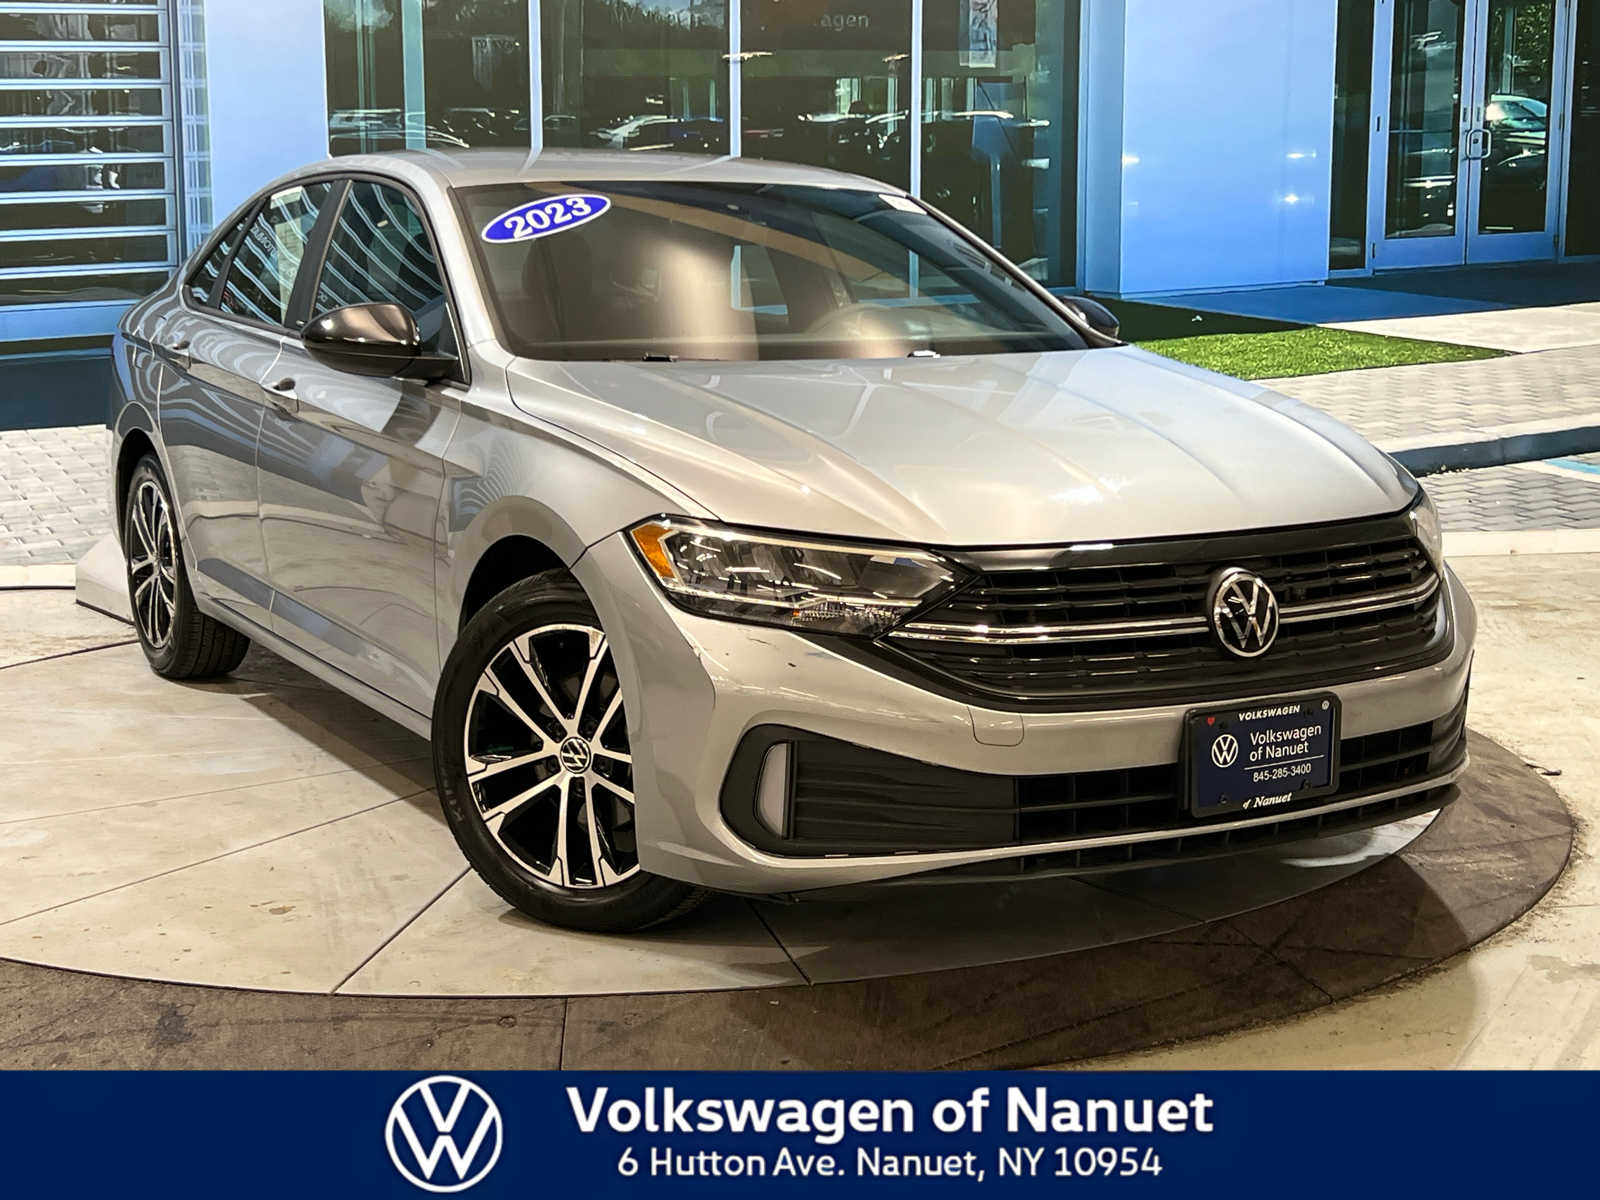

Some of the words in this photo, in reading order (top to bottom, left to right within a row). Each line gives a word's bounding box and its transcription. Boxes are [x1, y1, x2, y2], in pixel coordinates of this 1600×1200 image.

[504, 197, 592, 239] 2023
[1238, 705, 1301, 721] VOLKSWAGEN
[1250, 725, 1322, 746] Volkswagen
[1249, 746, 1263, 762] of
[1265, 742, 1309, 759] Nanuet
[1253, 763, 1312, 782] 845-285-3400
[1253, 792, 1293, 808] Nanuet
